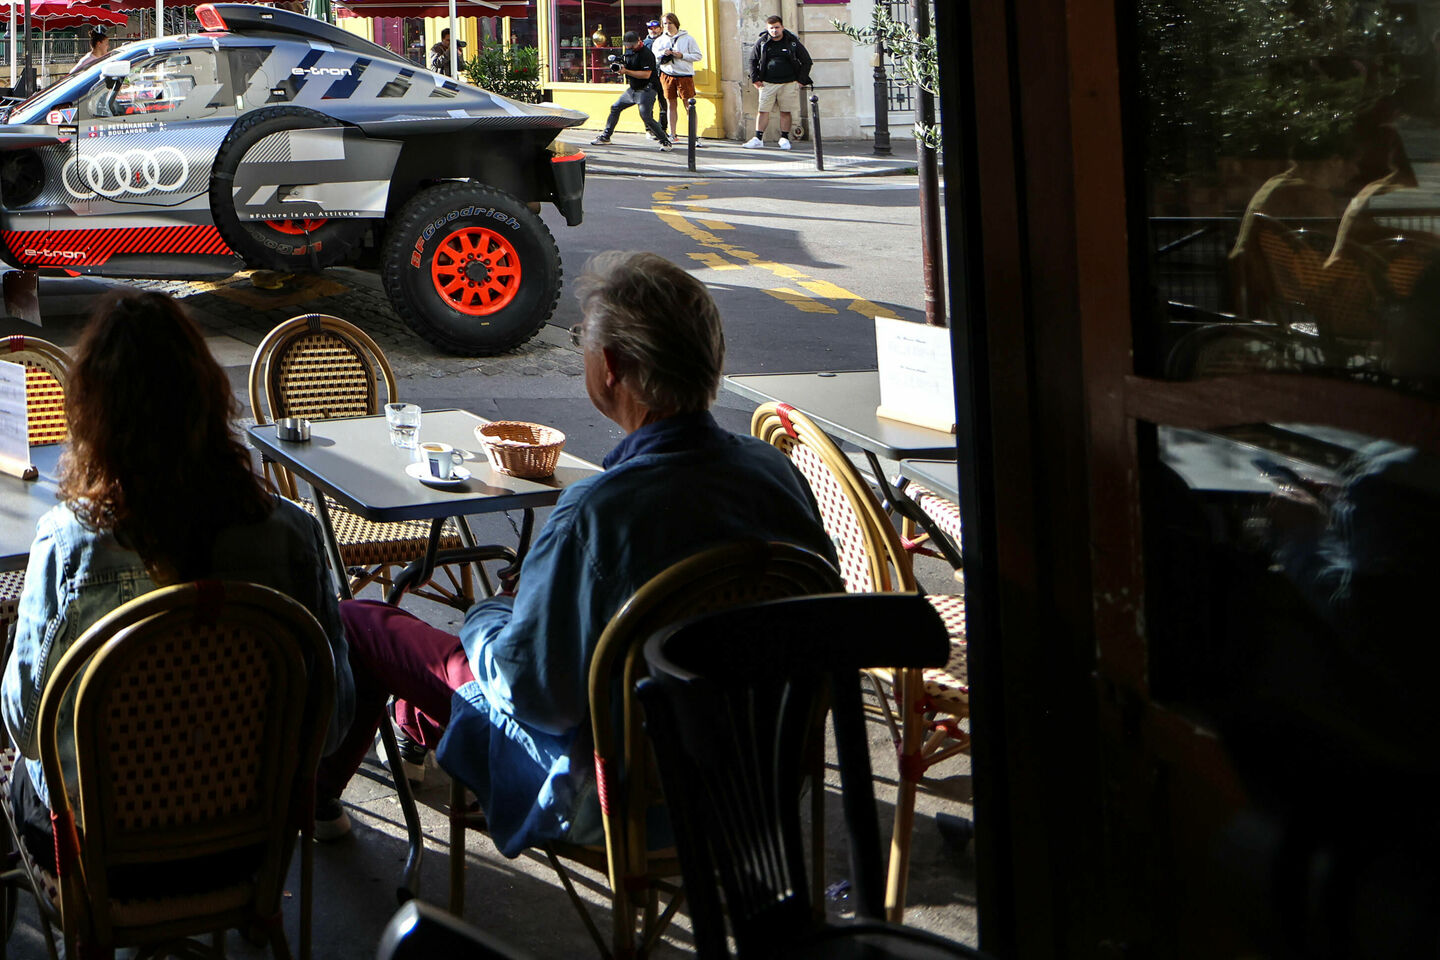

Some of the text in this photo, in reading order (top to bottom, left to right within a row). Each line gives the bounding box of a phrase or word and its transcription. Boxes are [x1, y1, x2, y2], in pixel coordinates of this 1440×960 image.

[291, 66, 352, 76] e-tron
[50, 112, 59, 124] E
[108, 122, 154, 131] PETERHANSEL
[108, 128, 148, 137] BOULANGER
[411, 205, 522, 269] BFGoodrich
[24, 248, 86, 259] e-tron
